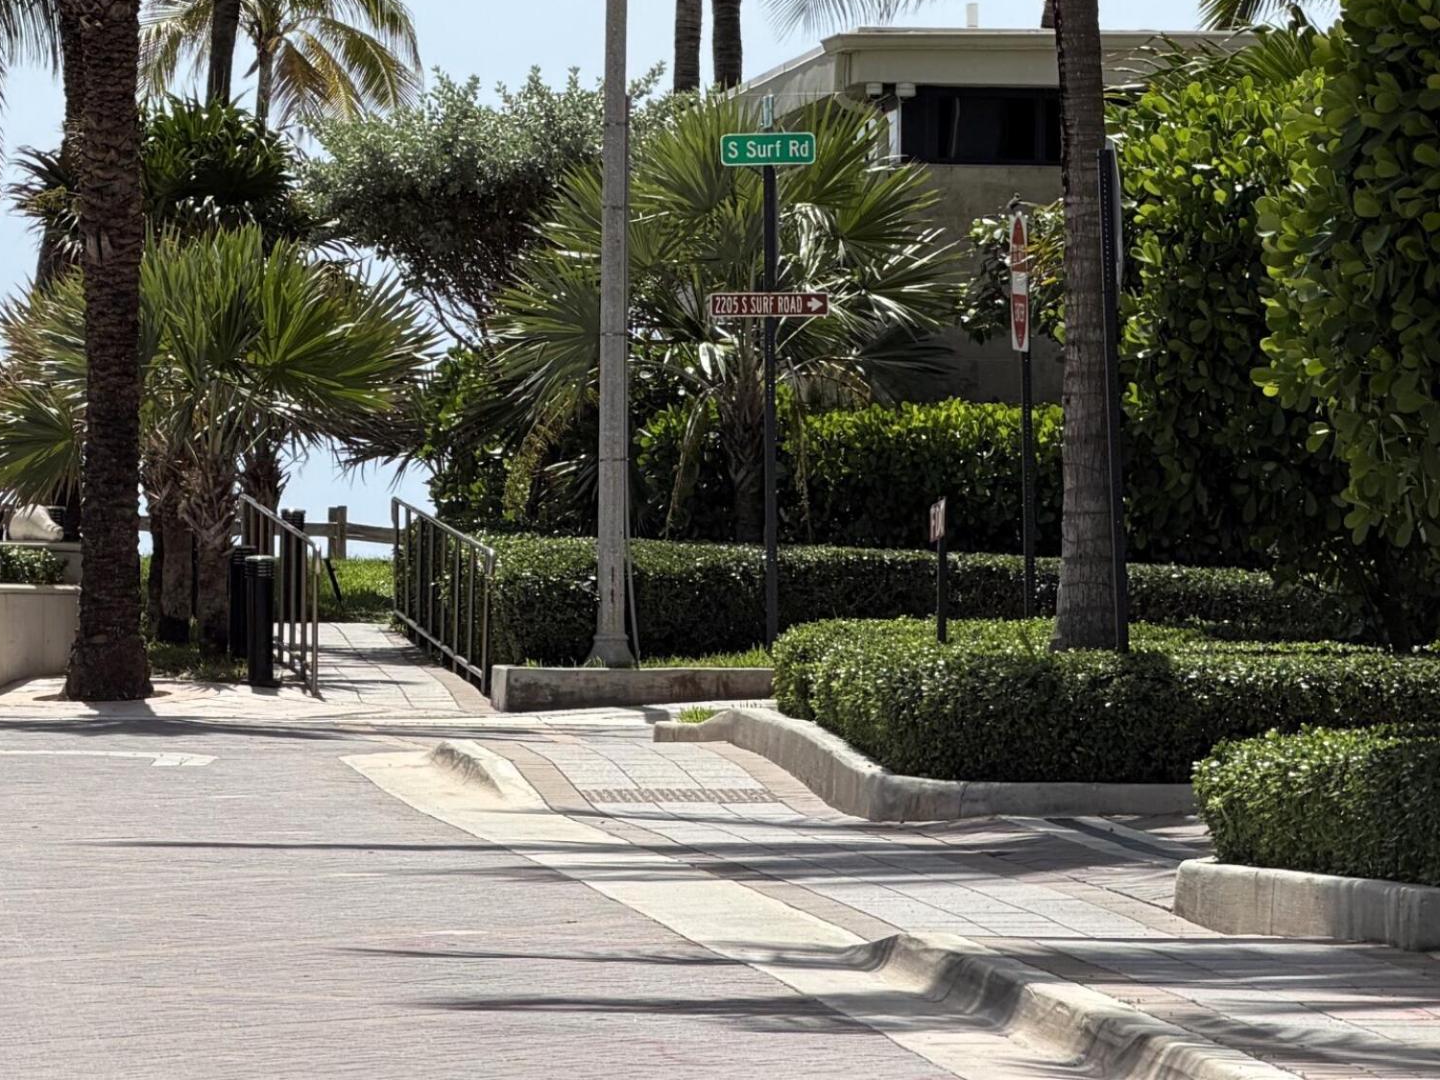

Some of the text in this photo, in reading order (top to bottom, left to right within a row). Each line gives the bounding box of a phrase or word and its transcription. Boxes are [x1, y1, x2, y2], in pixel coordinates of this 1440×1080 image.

[728, 140, 809, 158] S Surf Rd
[715, 296, 802, 314] 2205 S SURF ROAD
